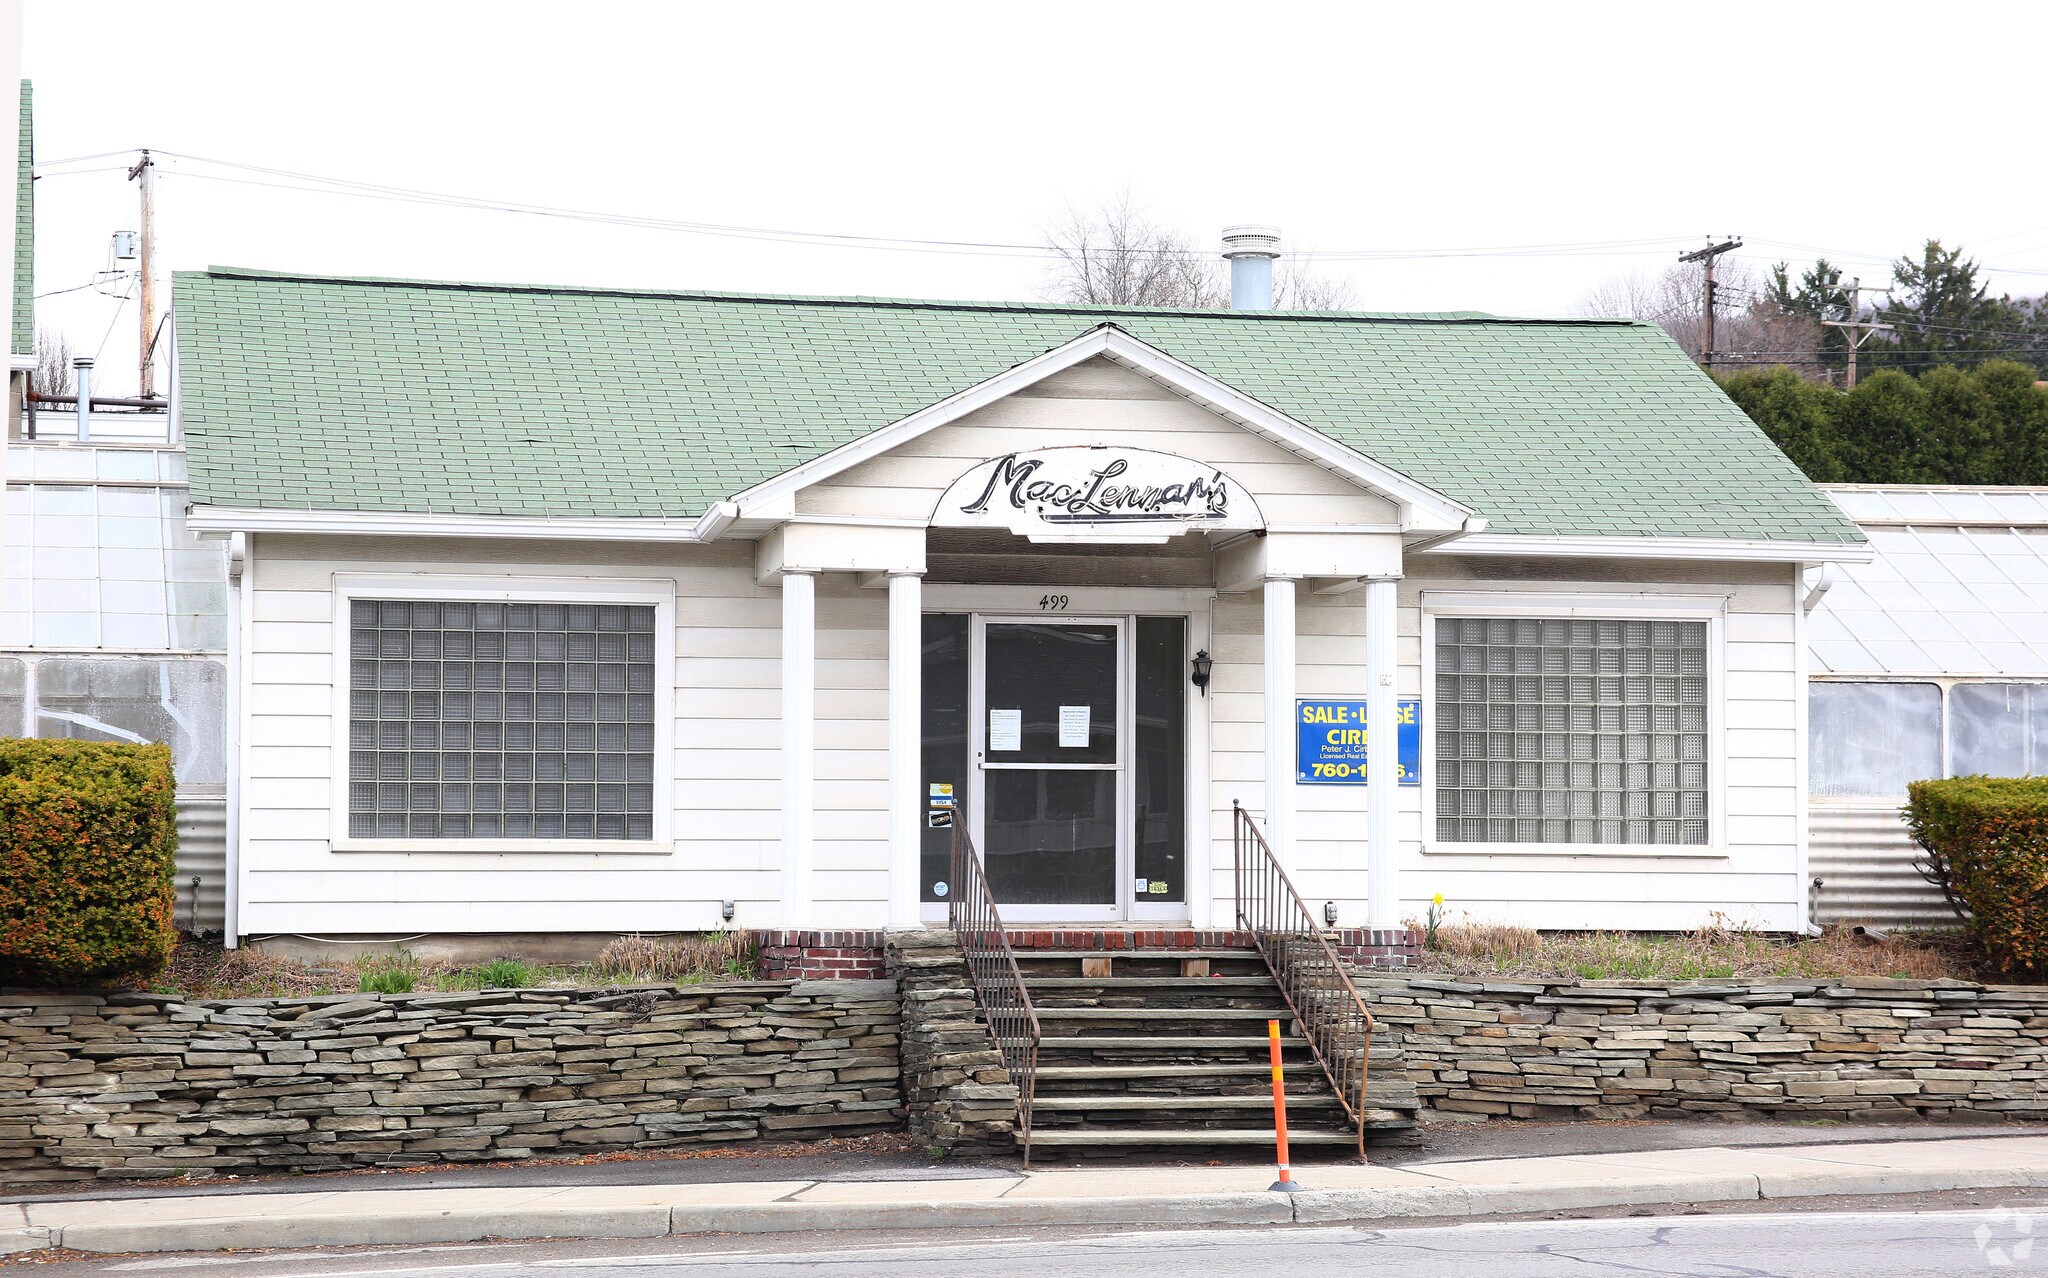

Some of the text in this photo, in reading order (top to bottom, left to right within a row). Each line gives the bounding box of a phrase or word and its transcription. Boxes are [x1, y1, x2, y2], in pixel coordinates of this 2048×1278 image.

[960, 455, 1229, 515] MacLennan's
[1039, 595, 1068, 610] 499
[1303, 706, 1348, 724] SALE
[1321, 745, 1342, 753] Peter
[1345, 745, 1351, 753] J.
[1312, 763, 1406, 777] 760-16
